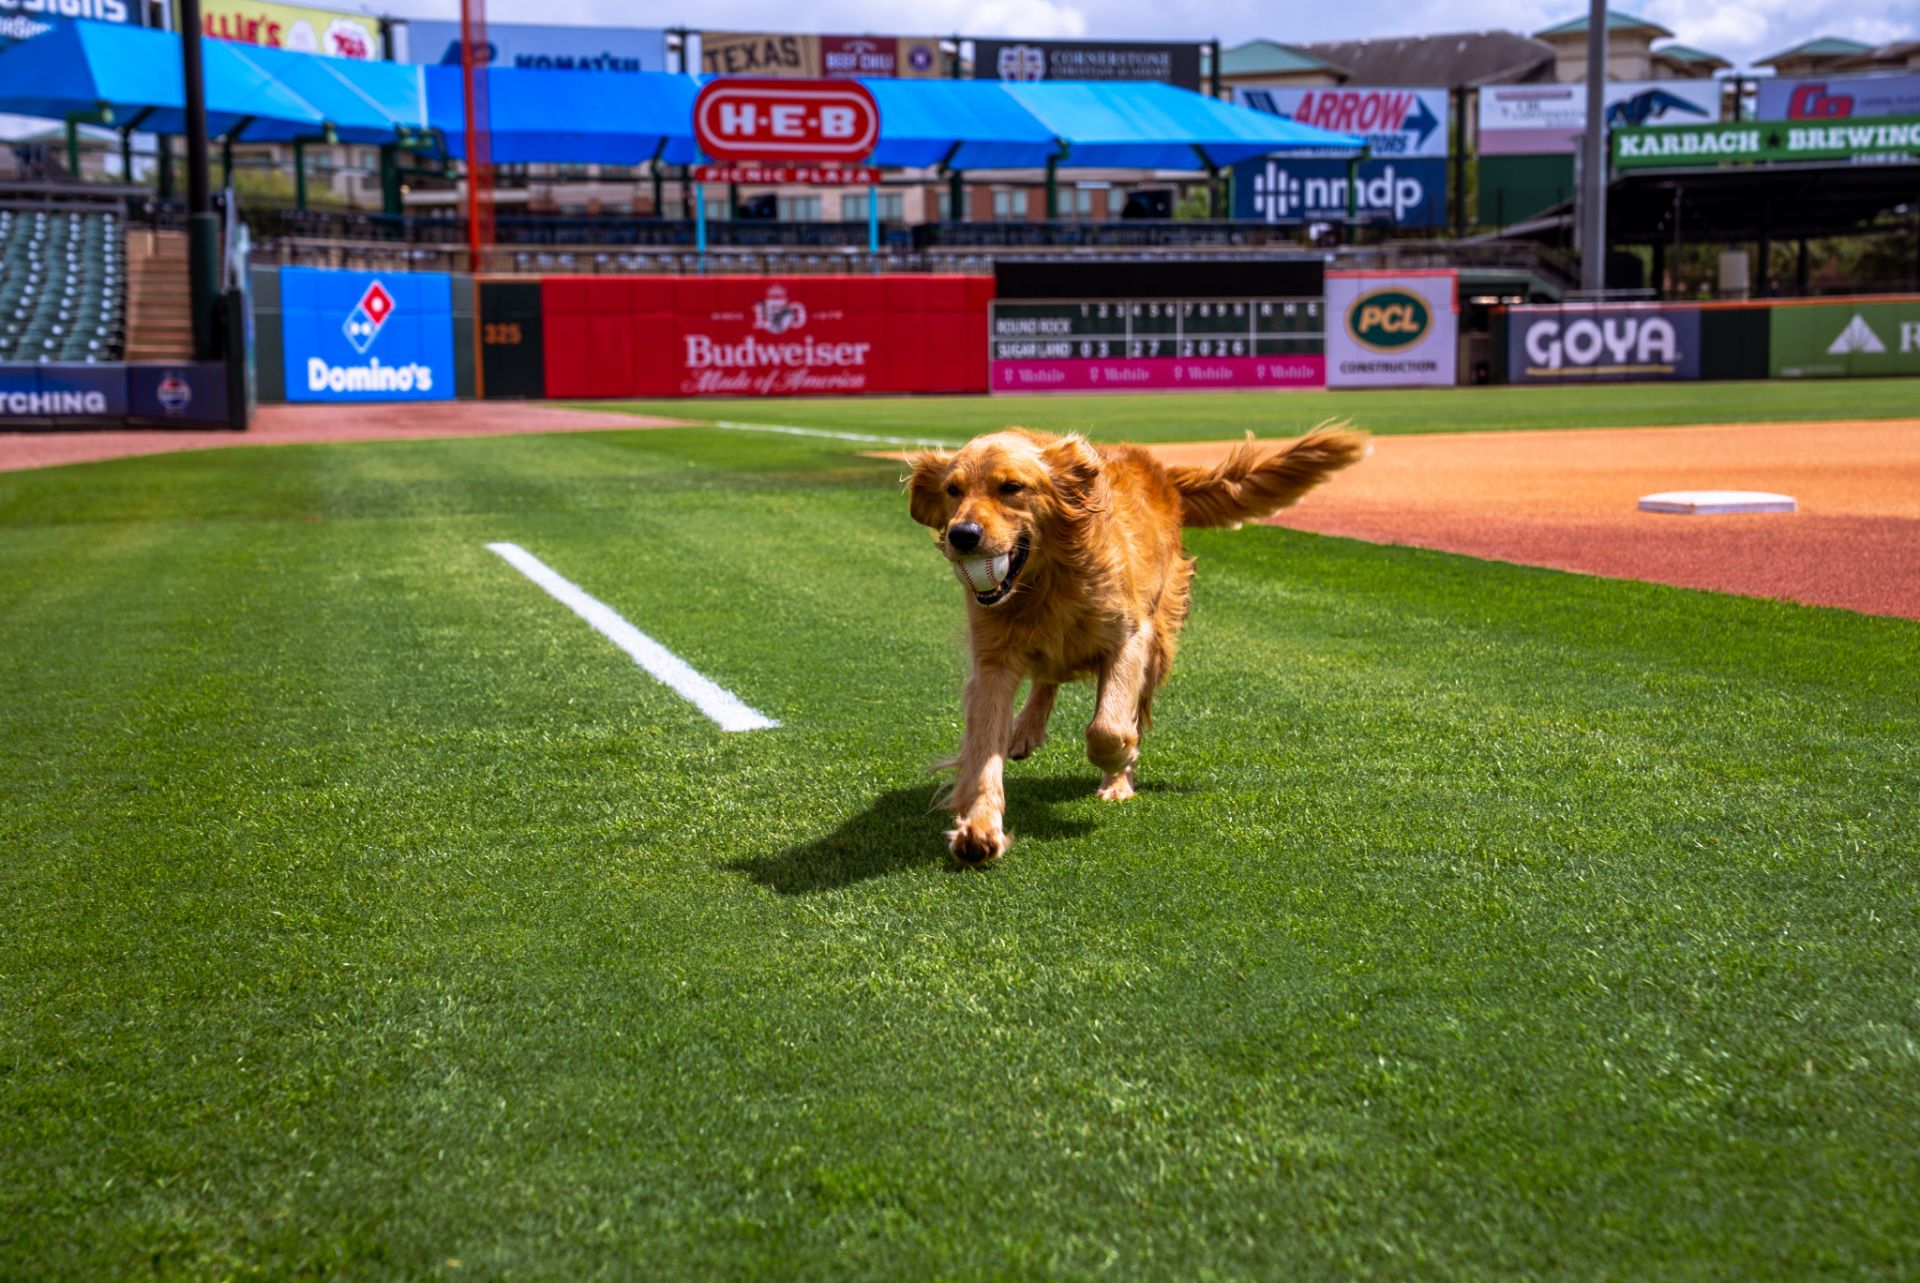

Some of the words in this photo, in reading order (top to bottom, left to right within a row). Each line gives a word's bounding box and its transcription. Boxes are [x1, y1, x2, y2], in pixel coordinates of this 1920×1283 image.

[704, 37, 800, 74] TEXAS
[1050, 52, 1170, 65] CORNERSTONE
[1291, 90, 1414, 132] ARROW
[1619, 131, 1760, 157] KARBACH
[705, 168, 785, 182] PICNIC
[795, 169, 871, 183] PLAZA
[1305, 164, 1423, 221] nmdp
[996, 317, 1036, 335] ROUND
[1039, 317, 1072, 334] ROCK
[1359, 303, 1419, 333] PCL
[484, 323, 522, 344] 325
[1525, 316, 1677, 369] GOYA
[684, 334, 871, 368] Budweiser
[997, 342, 1036, 359] SUGAR
[1038, 342, 1072, 358] LAND
[1131, 340, 1143, 357] 2
[1148, 340, 1160, 357] 7
[1184, 340, 1195, 357] 2
[1215, 340, 1227, 356] 2
[307, 356, 433, 392] Domino's
[680, 369, 750, 393] Made
[753, 368, 779, 395] of
[773, 368, 866, 392] America
[1340, 361, 1438, 375] CONSTRUCTION
